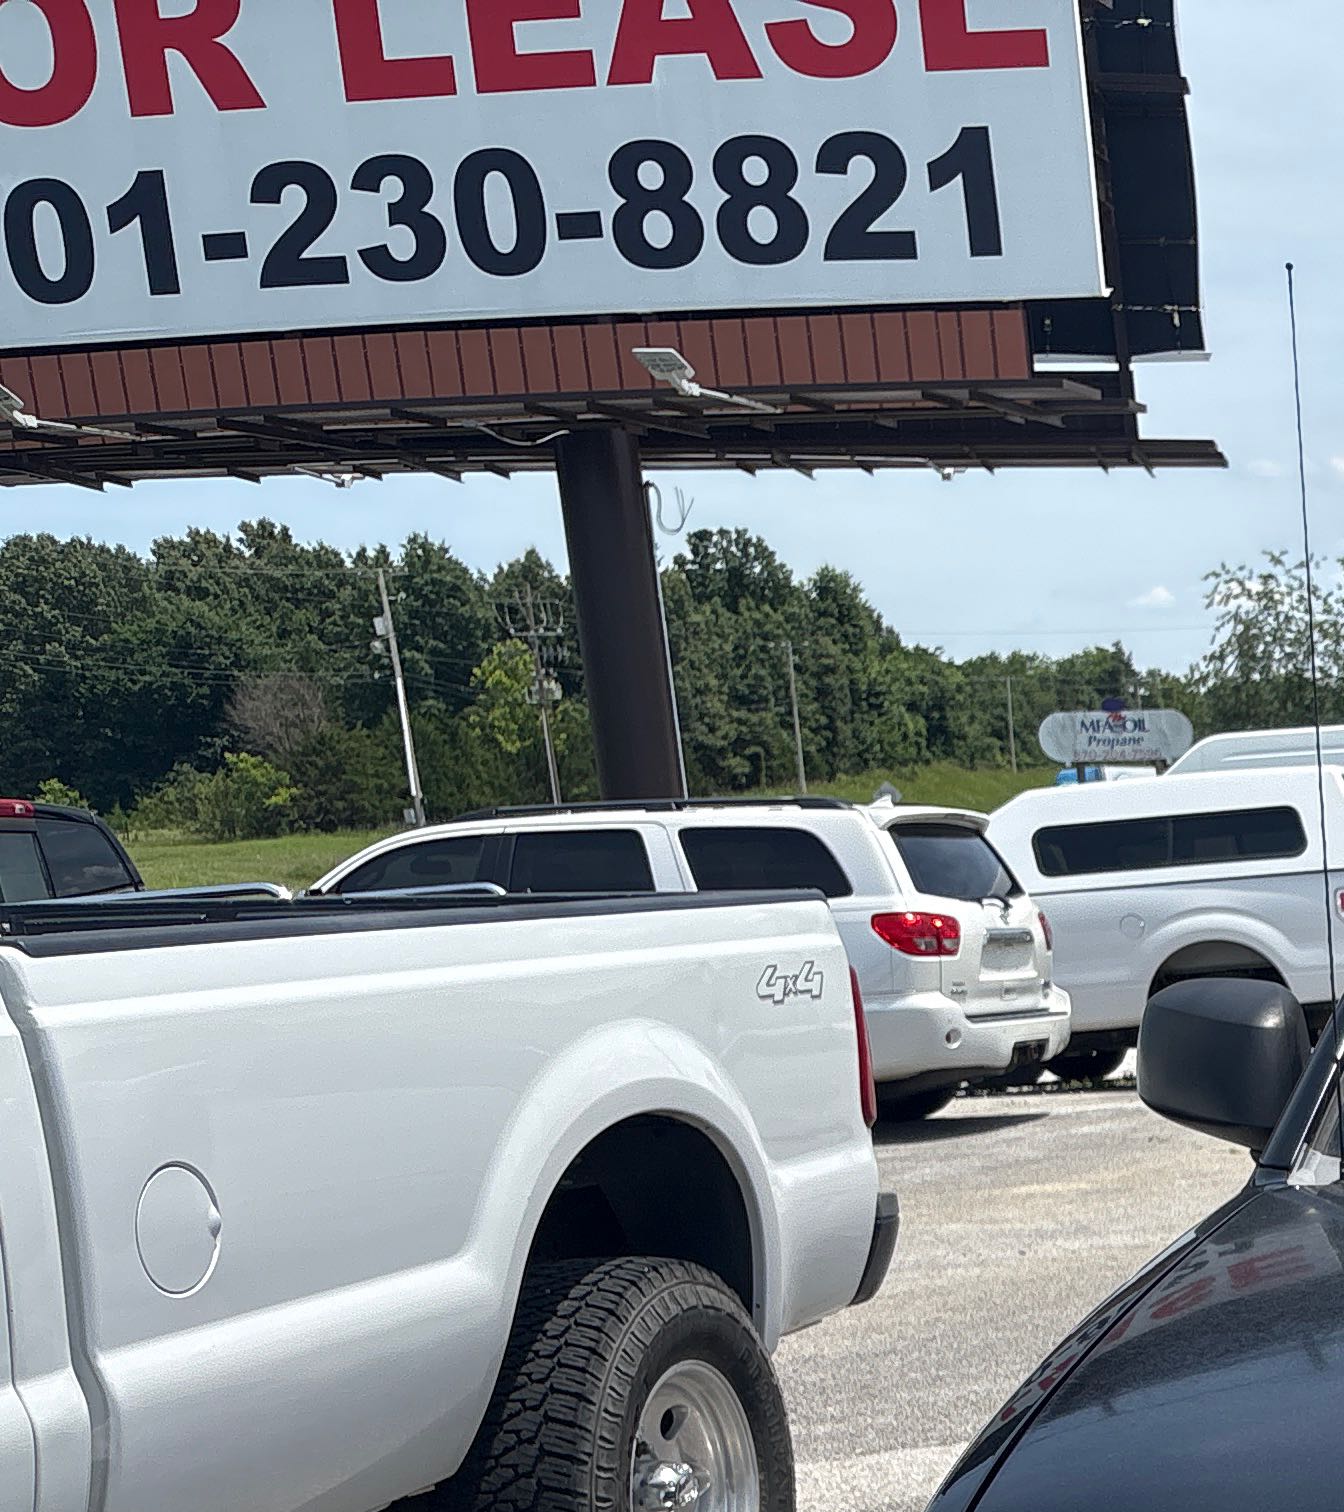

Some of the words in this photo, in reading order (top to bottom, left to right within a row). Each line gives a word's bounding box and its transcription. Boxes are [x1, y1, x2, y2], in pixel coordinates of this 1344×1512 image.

[3, 125, 1004, 305] 01-230-8821
[1087, 735, 1145, 750] Propane
[756, 960, 824, 1005] 4x4
